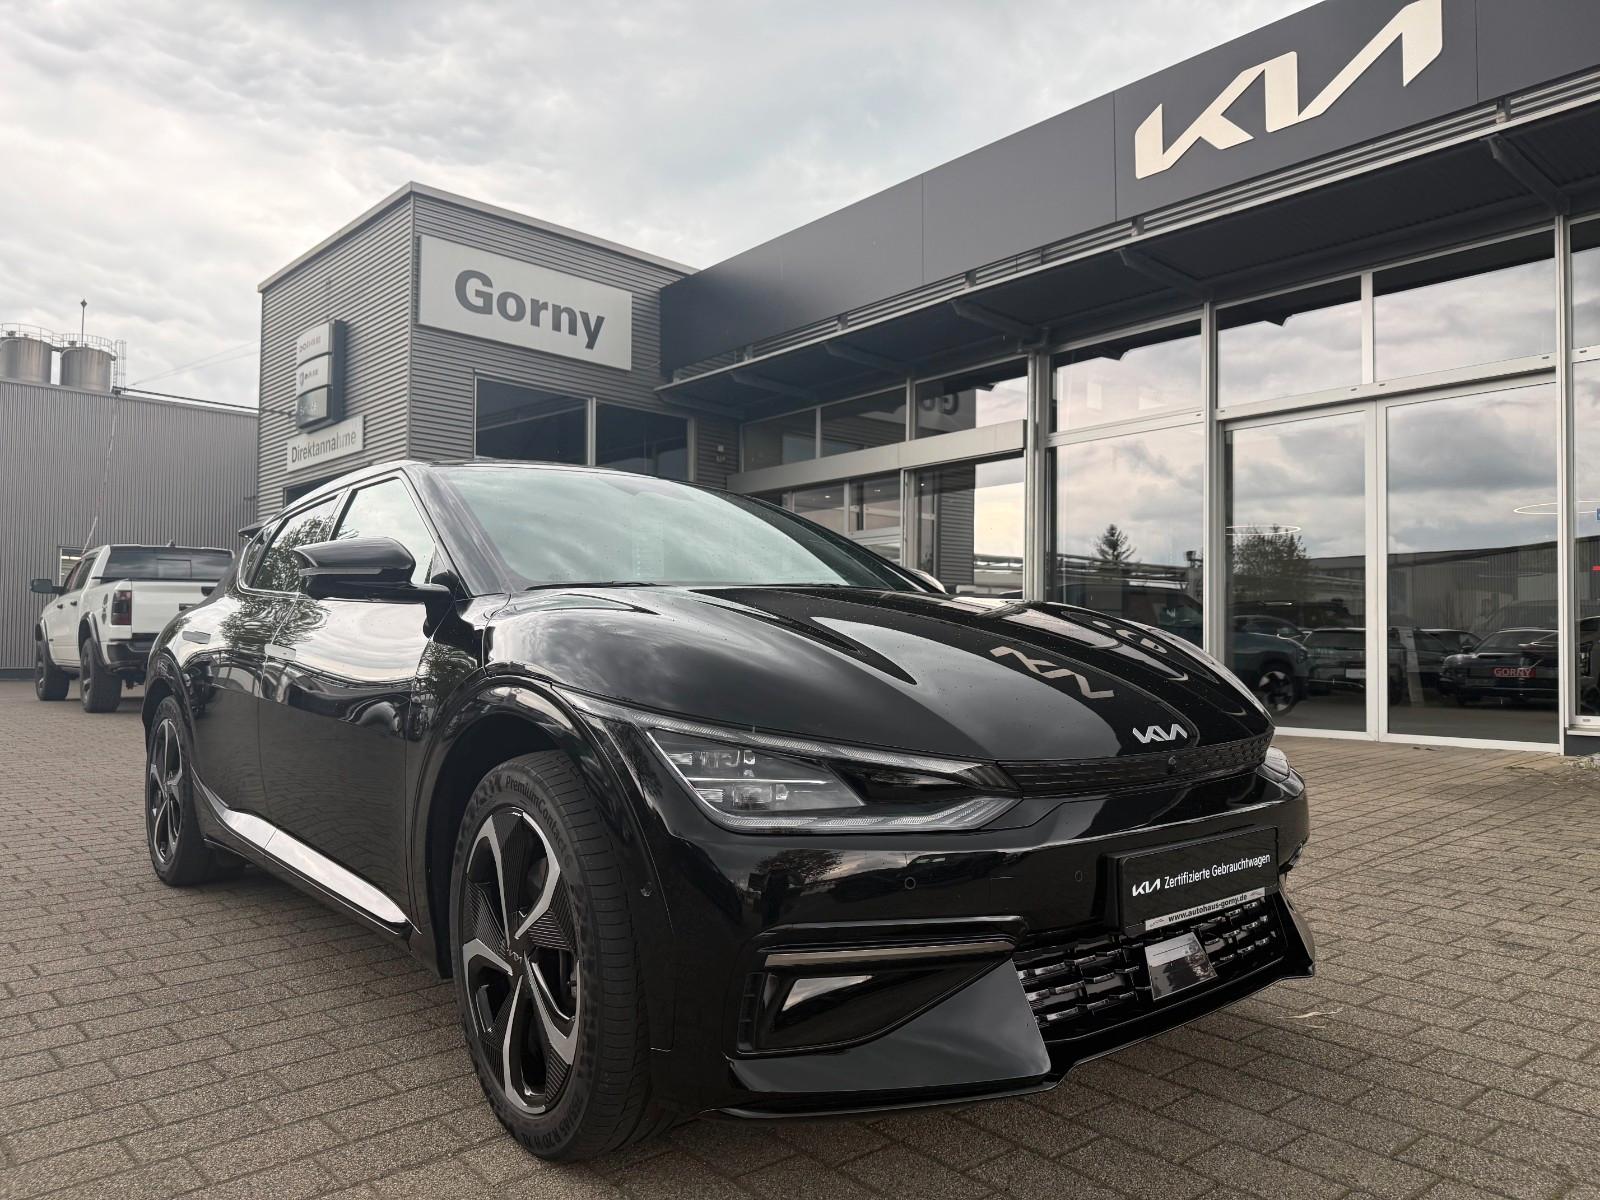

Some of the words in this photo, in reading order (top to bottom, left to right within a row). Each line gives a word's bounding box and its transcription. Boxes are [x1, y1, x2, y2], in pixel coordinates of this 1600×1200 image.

[1135, 0, 1443, 180] KIA
[454, 269, 606, 350] Gorny
[1132, 723, 1188, 744] KIA
[1131, 878, 1161, 897] KIA
[1164, 868, 1211, 889] Zertifizierte
[1211, 854, 1271, 877] Gebrauchtwagen
[1168, 893, 1248, 923] www.autohaus-gorny.de
